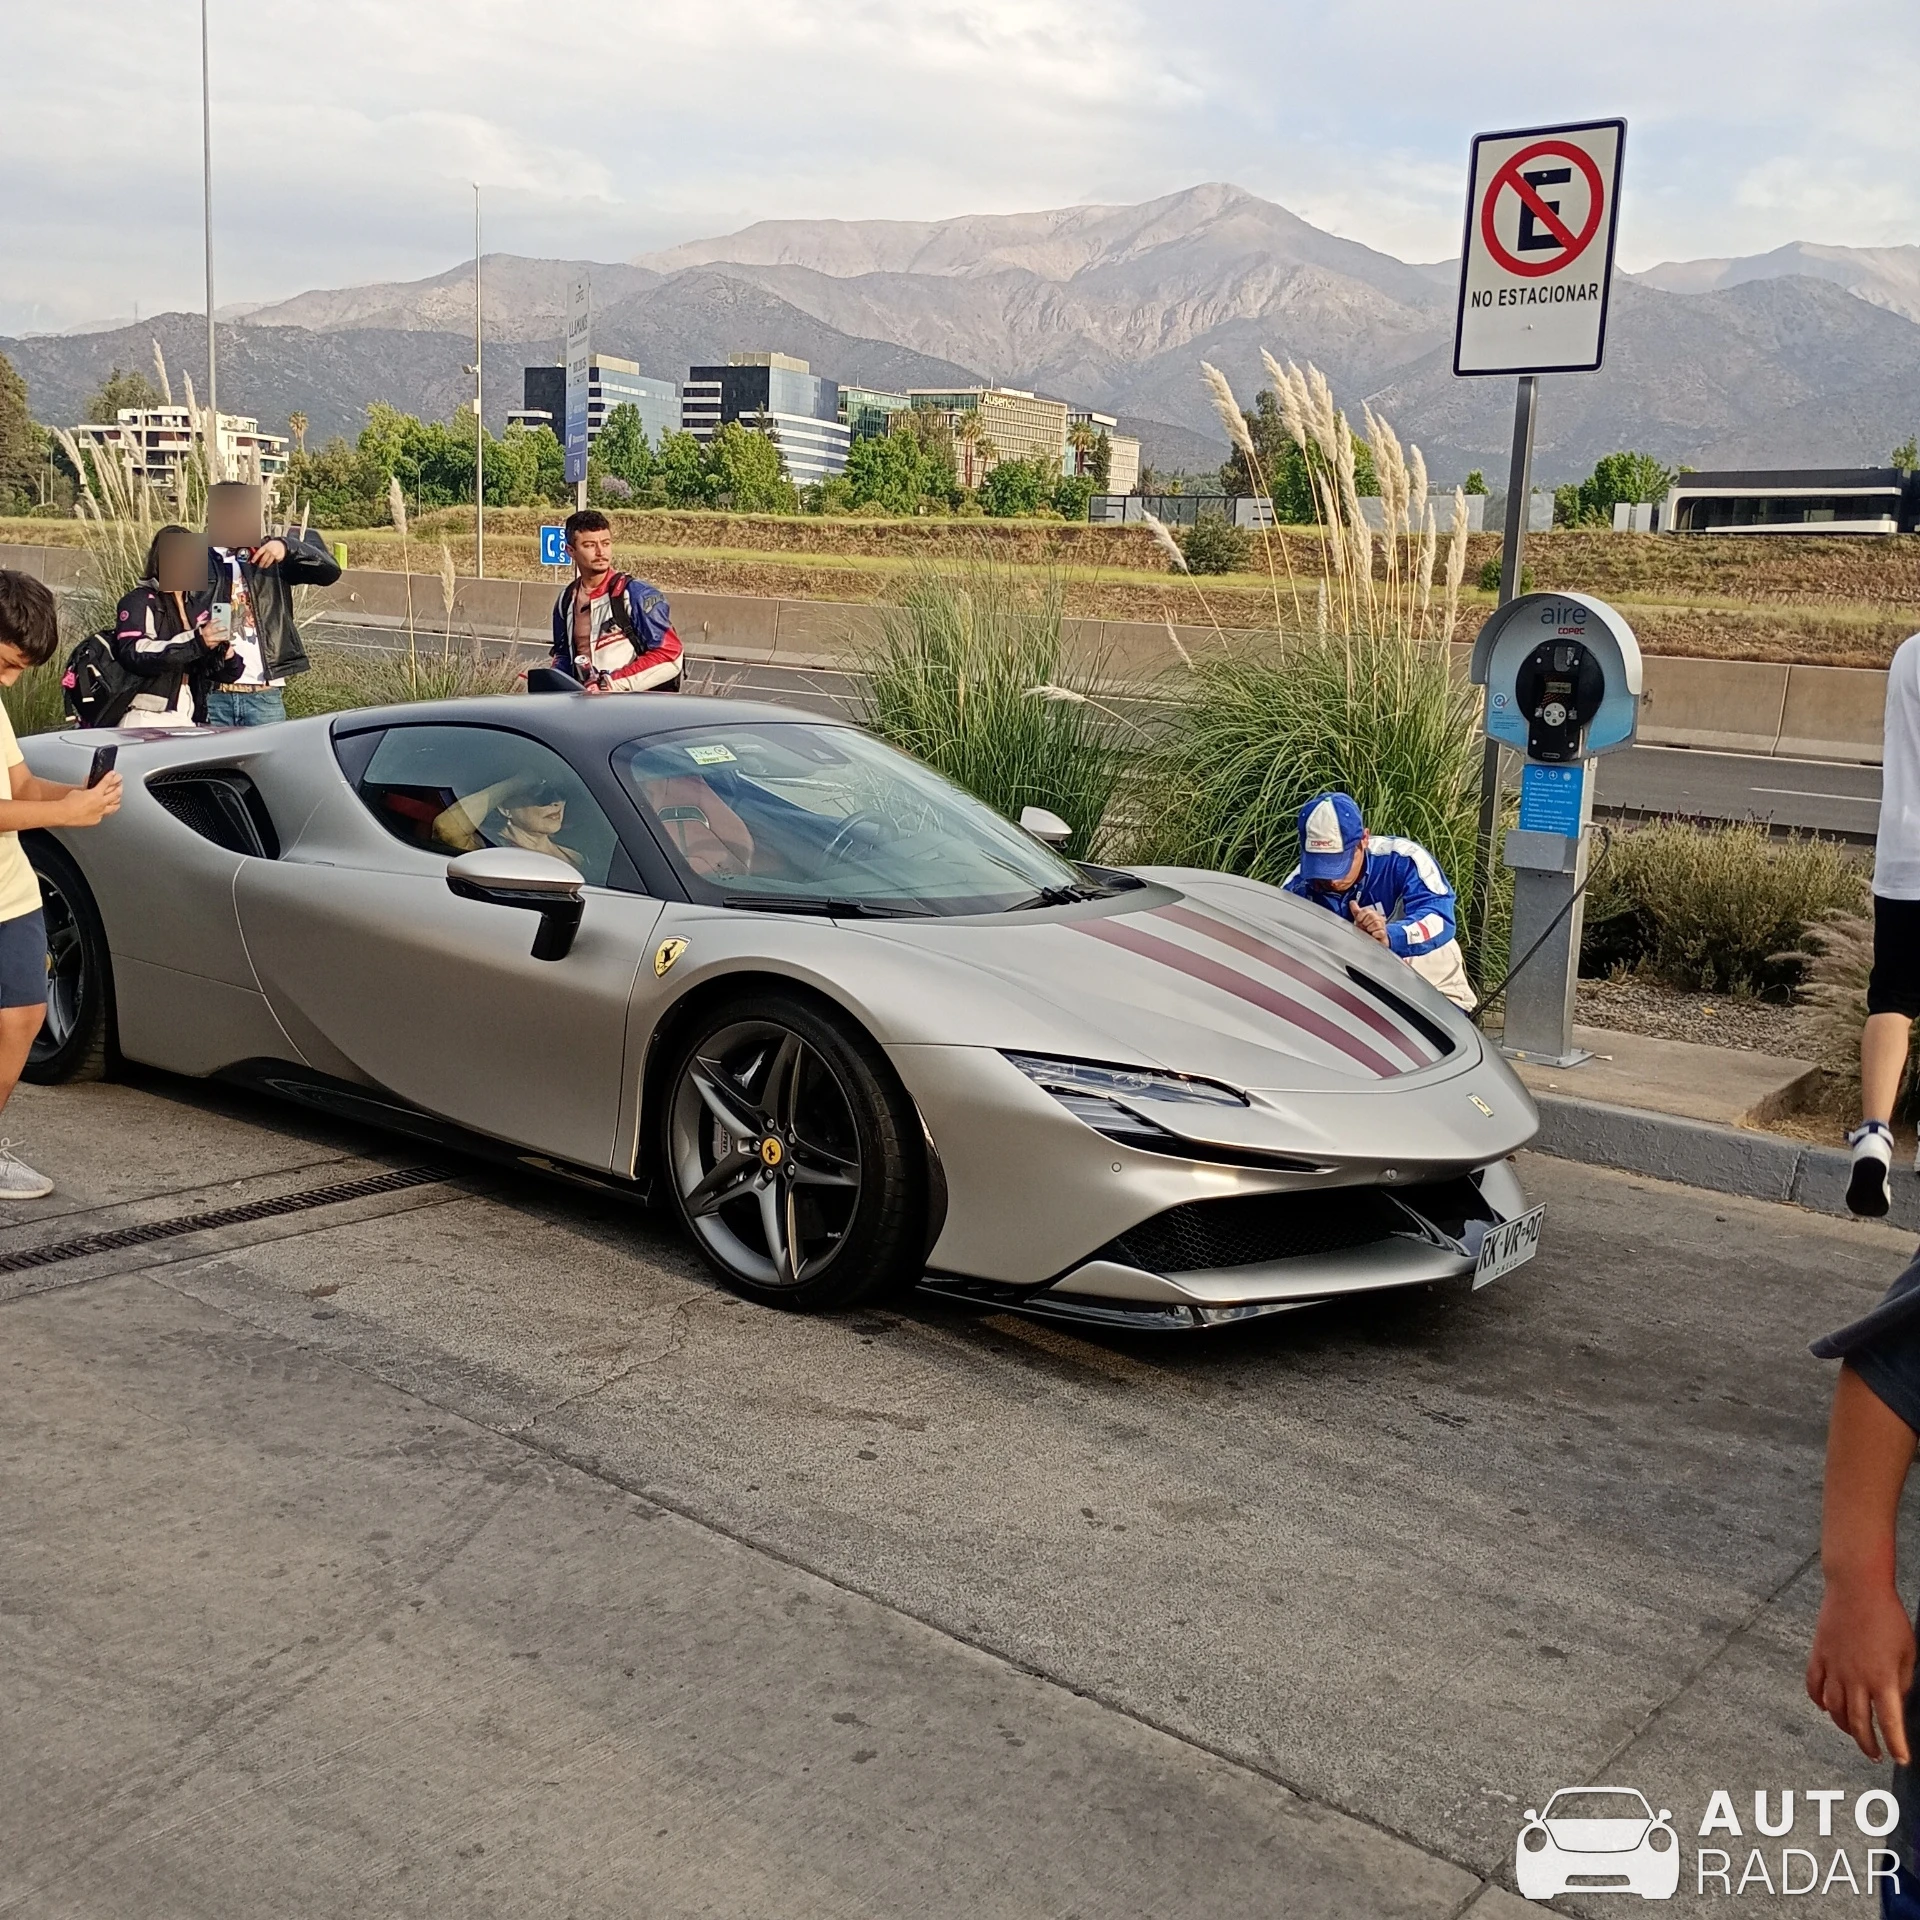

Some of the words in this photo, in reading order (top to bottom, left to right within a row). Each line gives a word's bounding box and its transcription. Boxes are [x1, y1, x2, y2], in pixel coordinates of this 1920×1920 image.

[1471, 290, 1493, 308] NO
[1498, 283, 1598, 306] ESTACIONAR
[983, 391, 1017, 409] Ausenco
[1541, 602, 1587, 624] aire
